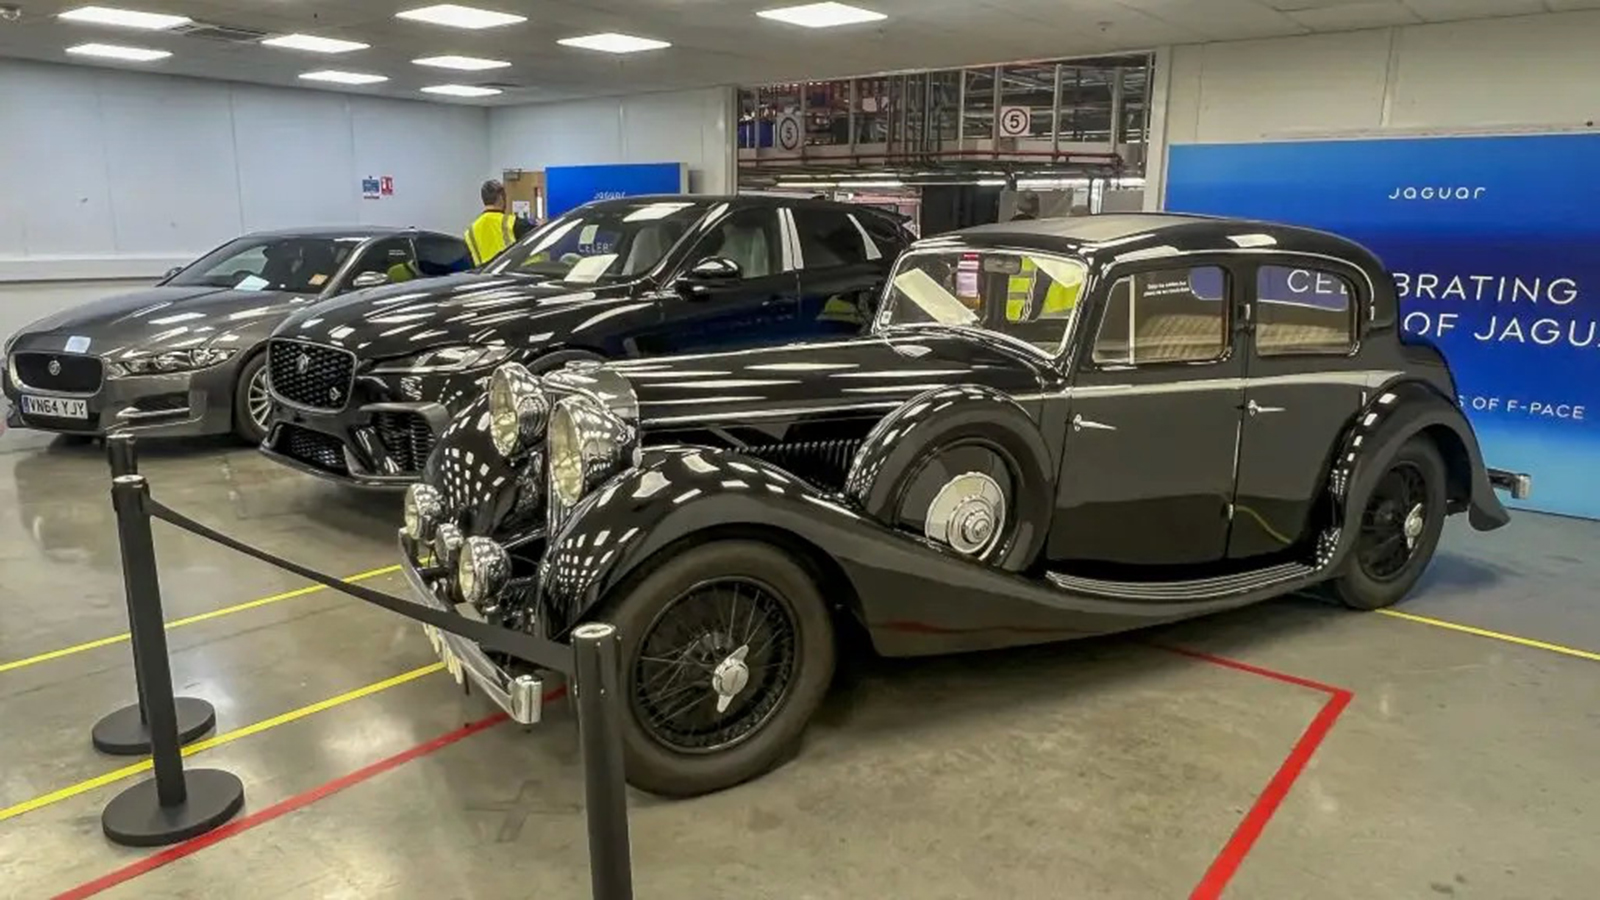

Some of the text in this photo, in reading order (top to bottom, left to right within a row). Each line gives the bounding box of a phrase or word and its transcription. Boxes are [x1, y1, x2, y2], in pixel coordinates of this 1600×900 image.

[1010, 115, 1020, 129] 5
[786, 127, 793, 140] 5
[1287, 269, 1578, 305] CEBRATING
[1404, 311, 1600, 347] OF JAGU
[29, 398, 59, 414] VN64
[1472, 396, 1500, 411] OF
[1507, 400, 1586, 419] F-PACE
